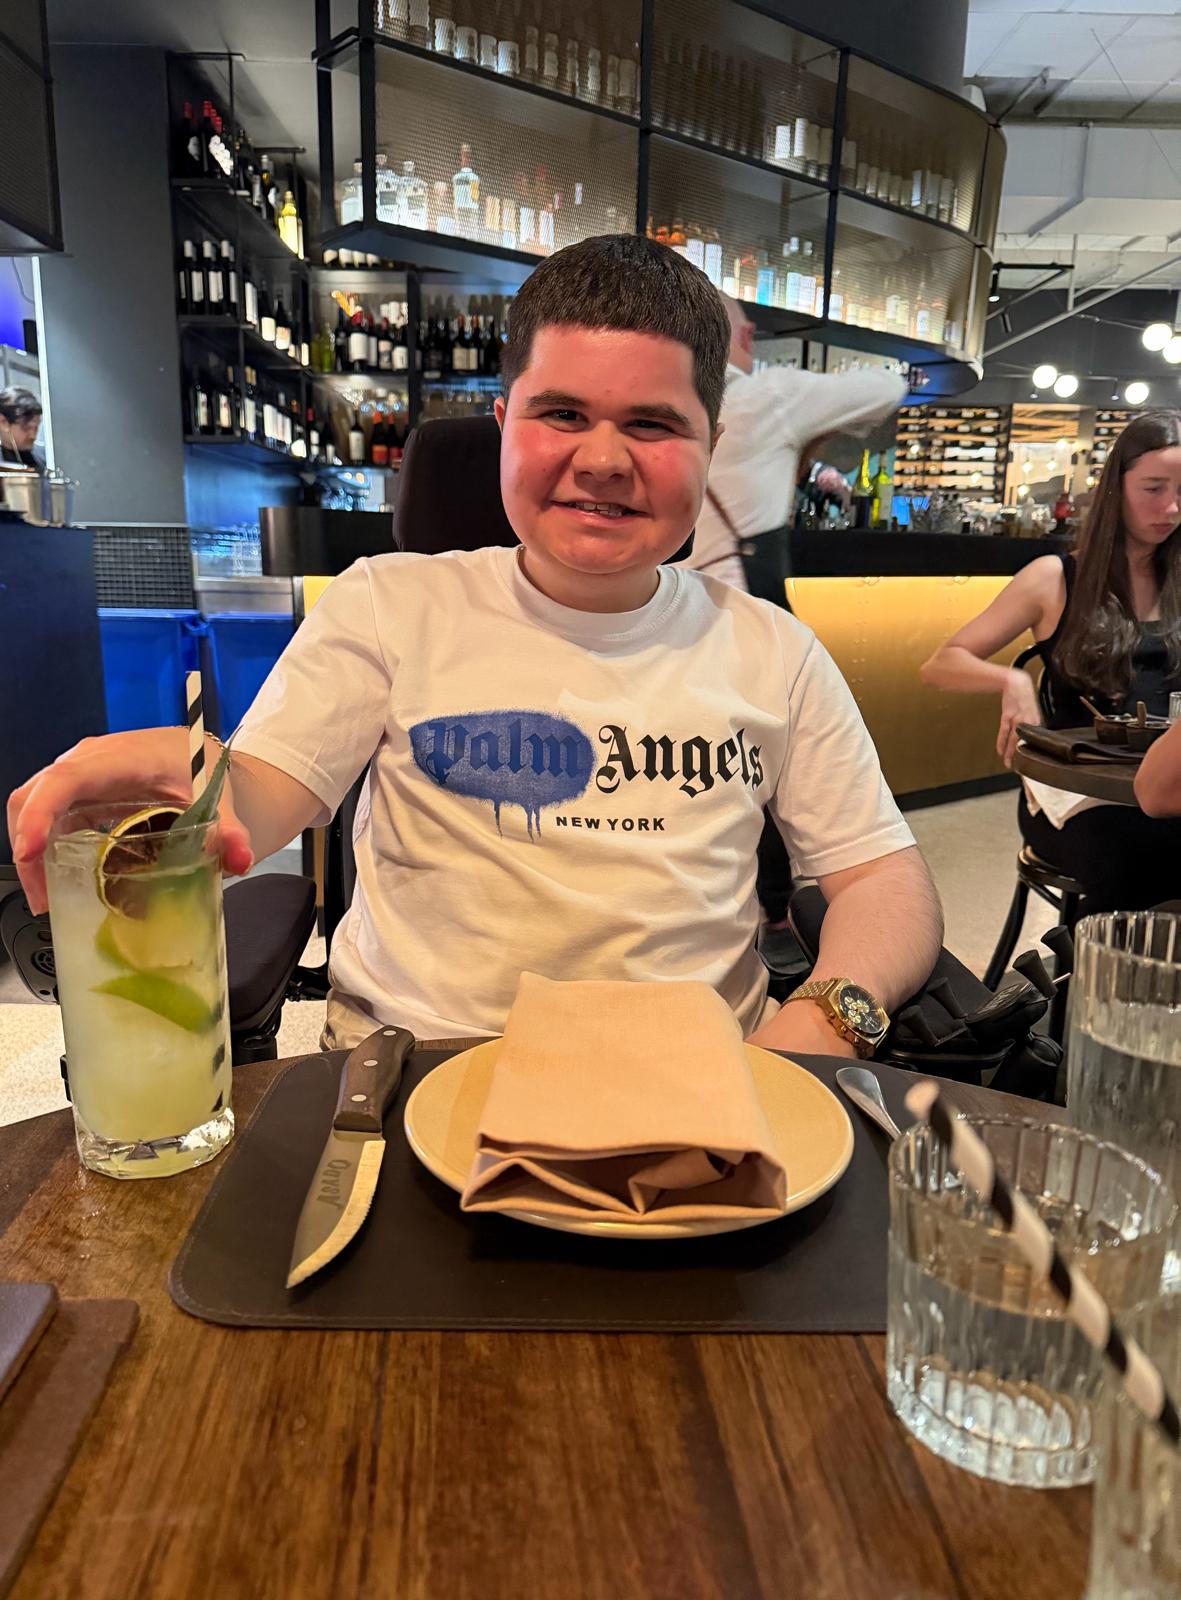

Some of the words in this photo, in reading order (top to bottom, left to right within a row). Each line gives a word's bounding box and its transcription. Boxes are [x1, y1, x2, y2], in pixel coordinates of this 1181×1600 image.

[425, 718, 584, 786] Palm
[595, 724, 764, 799] Angels
[556, 816, 600, 830] NEW
[606, 817, 665, 831] YORK
[316, 1159, 352, 1209] ASADO
